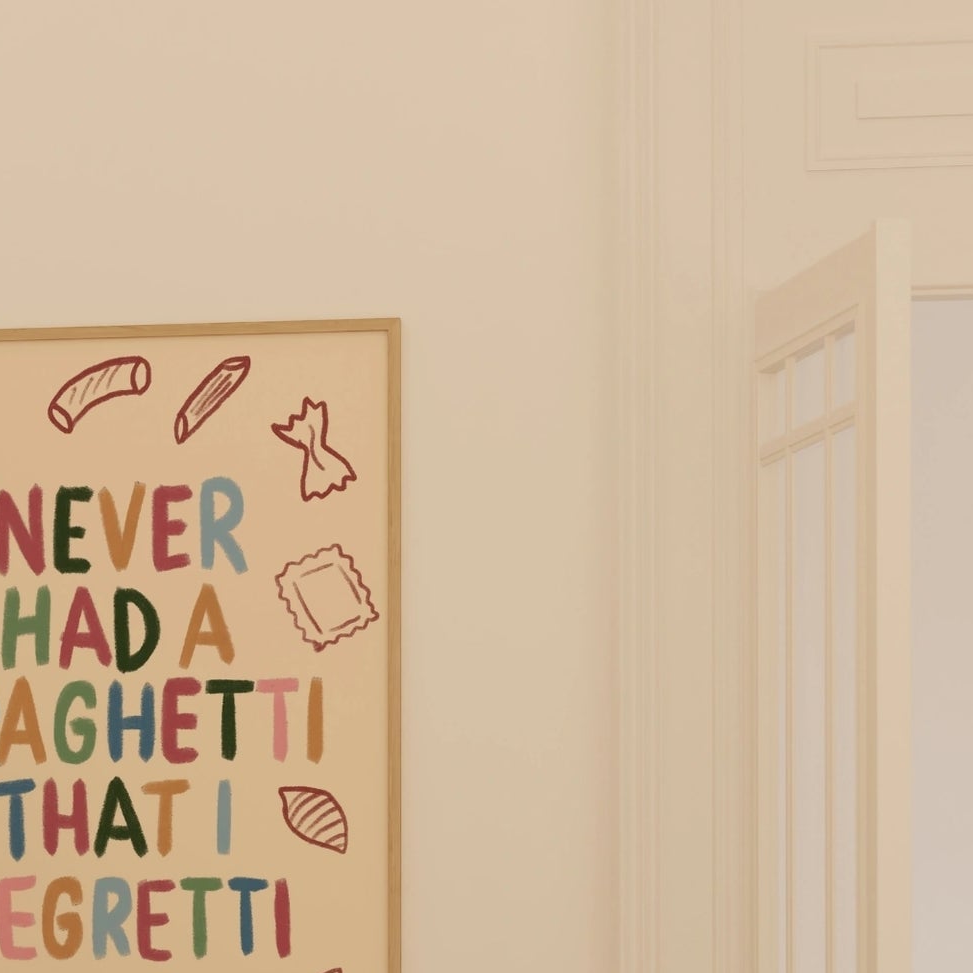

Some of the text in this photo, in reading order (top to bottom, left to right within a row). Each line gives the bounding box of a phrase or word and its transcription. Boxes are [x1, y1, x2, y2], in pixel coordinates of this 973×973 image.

[0, 583, 236, 674] HAD A
[216, 779, 232, 857] I
